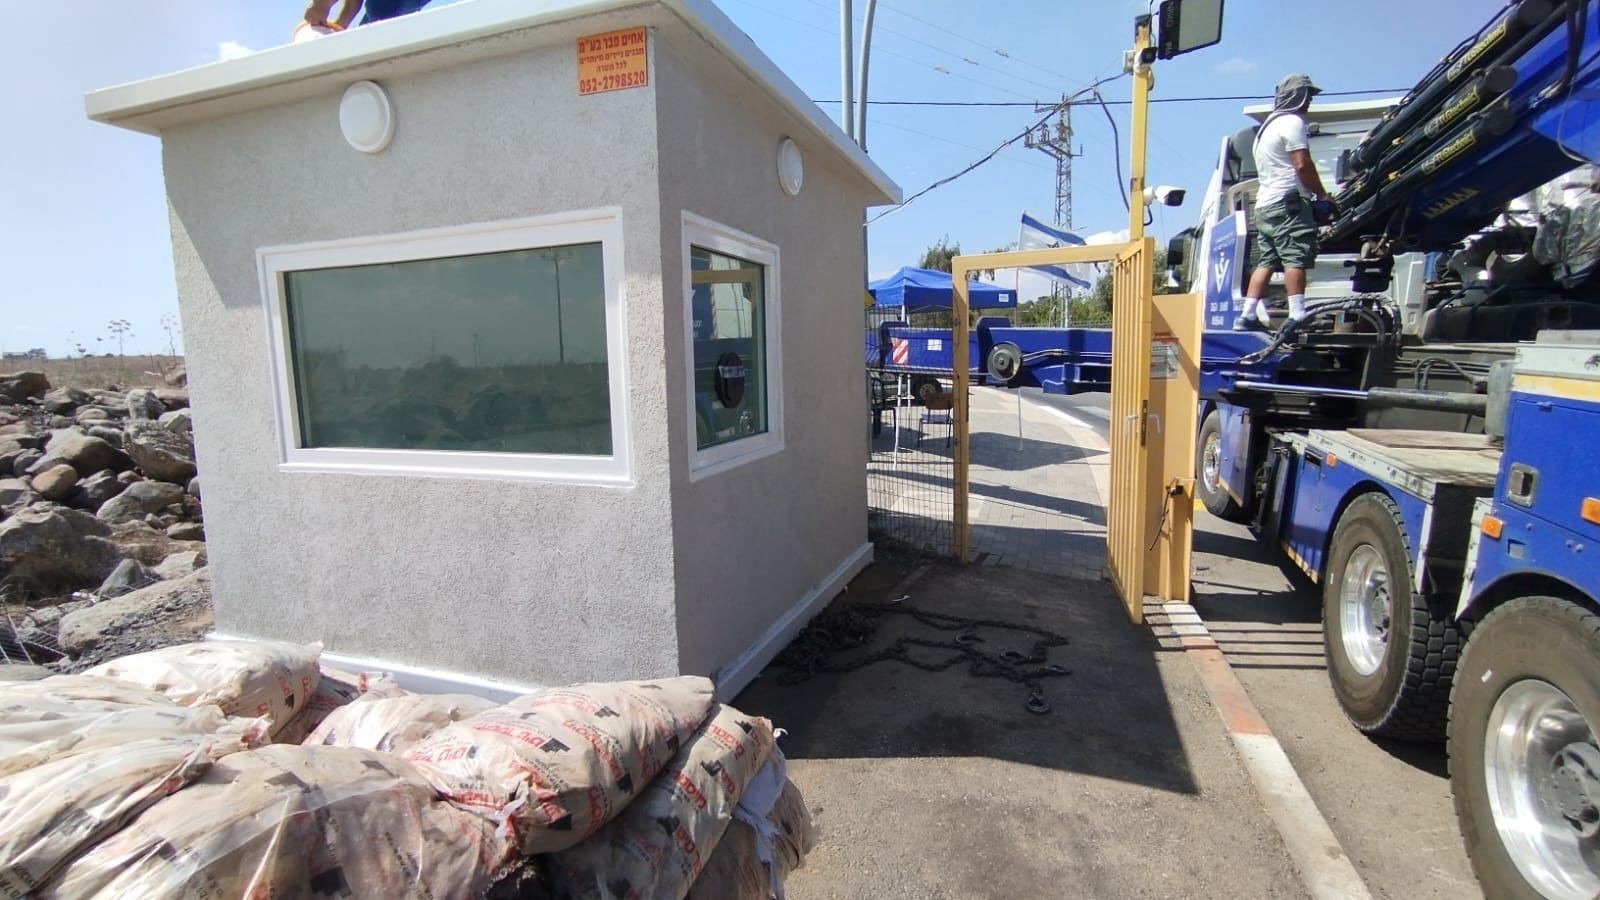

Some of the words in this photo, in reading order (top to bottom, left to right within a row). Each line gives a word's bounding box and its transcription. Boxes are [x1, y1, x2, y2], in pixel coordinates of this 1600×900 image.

[621, 31, 644, 46] אחים
[625, 47, 644, 57] מבנים
[596, 64, 615, 73] מטרה
[615, 60, 627, 69] לכל
[580, 70, 645, 93] 052-2798520
